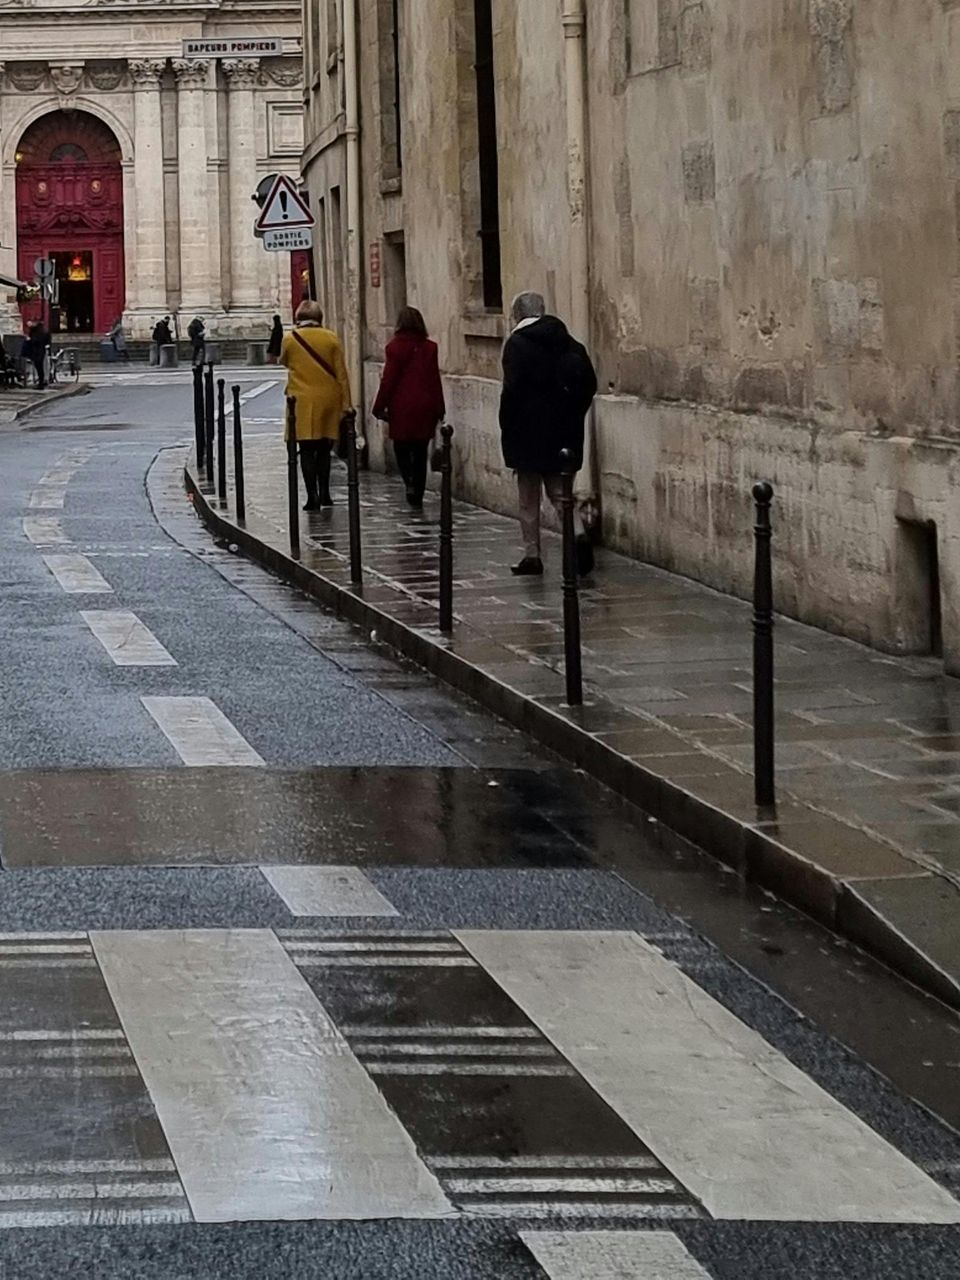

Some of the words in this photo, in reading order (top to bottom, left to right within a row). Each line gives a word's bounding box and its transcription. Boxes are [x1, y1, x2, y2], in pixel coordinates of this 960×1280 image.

[187, 44, 227, 52] SAPEURS
[231, 42, 276, 51] POMPIERS
[273, 231, 302, 240] SORTIE
[267, 239, 309, 248] POMPIERS
